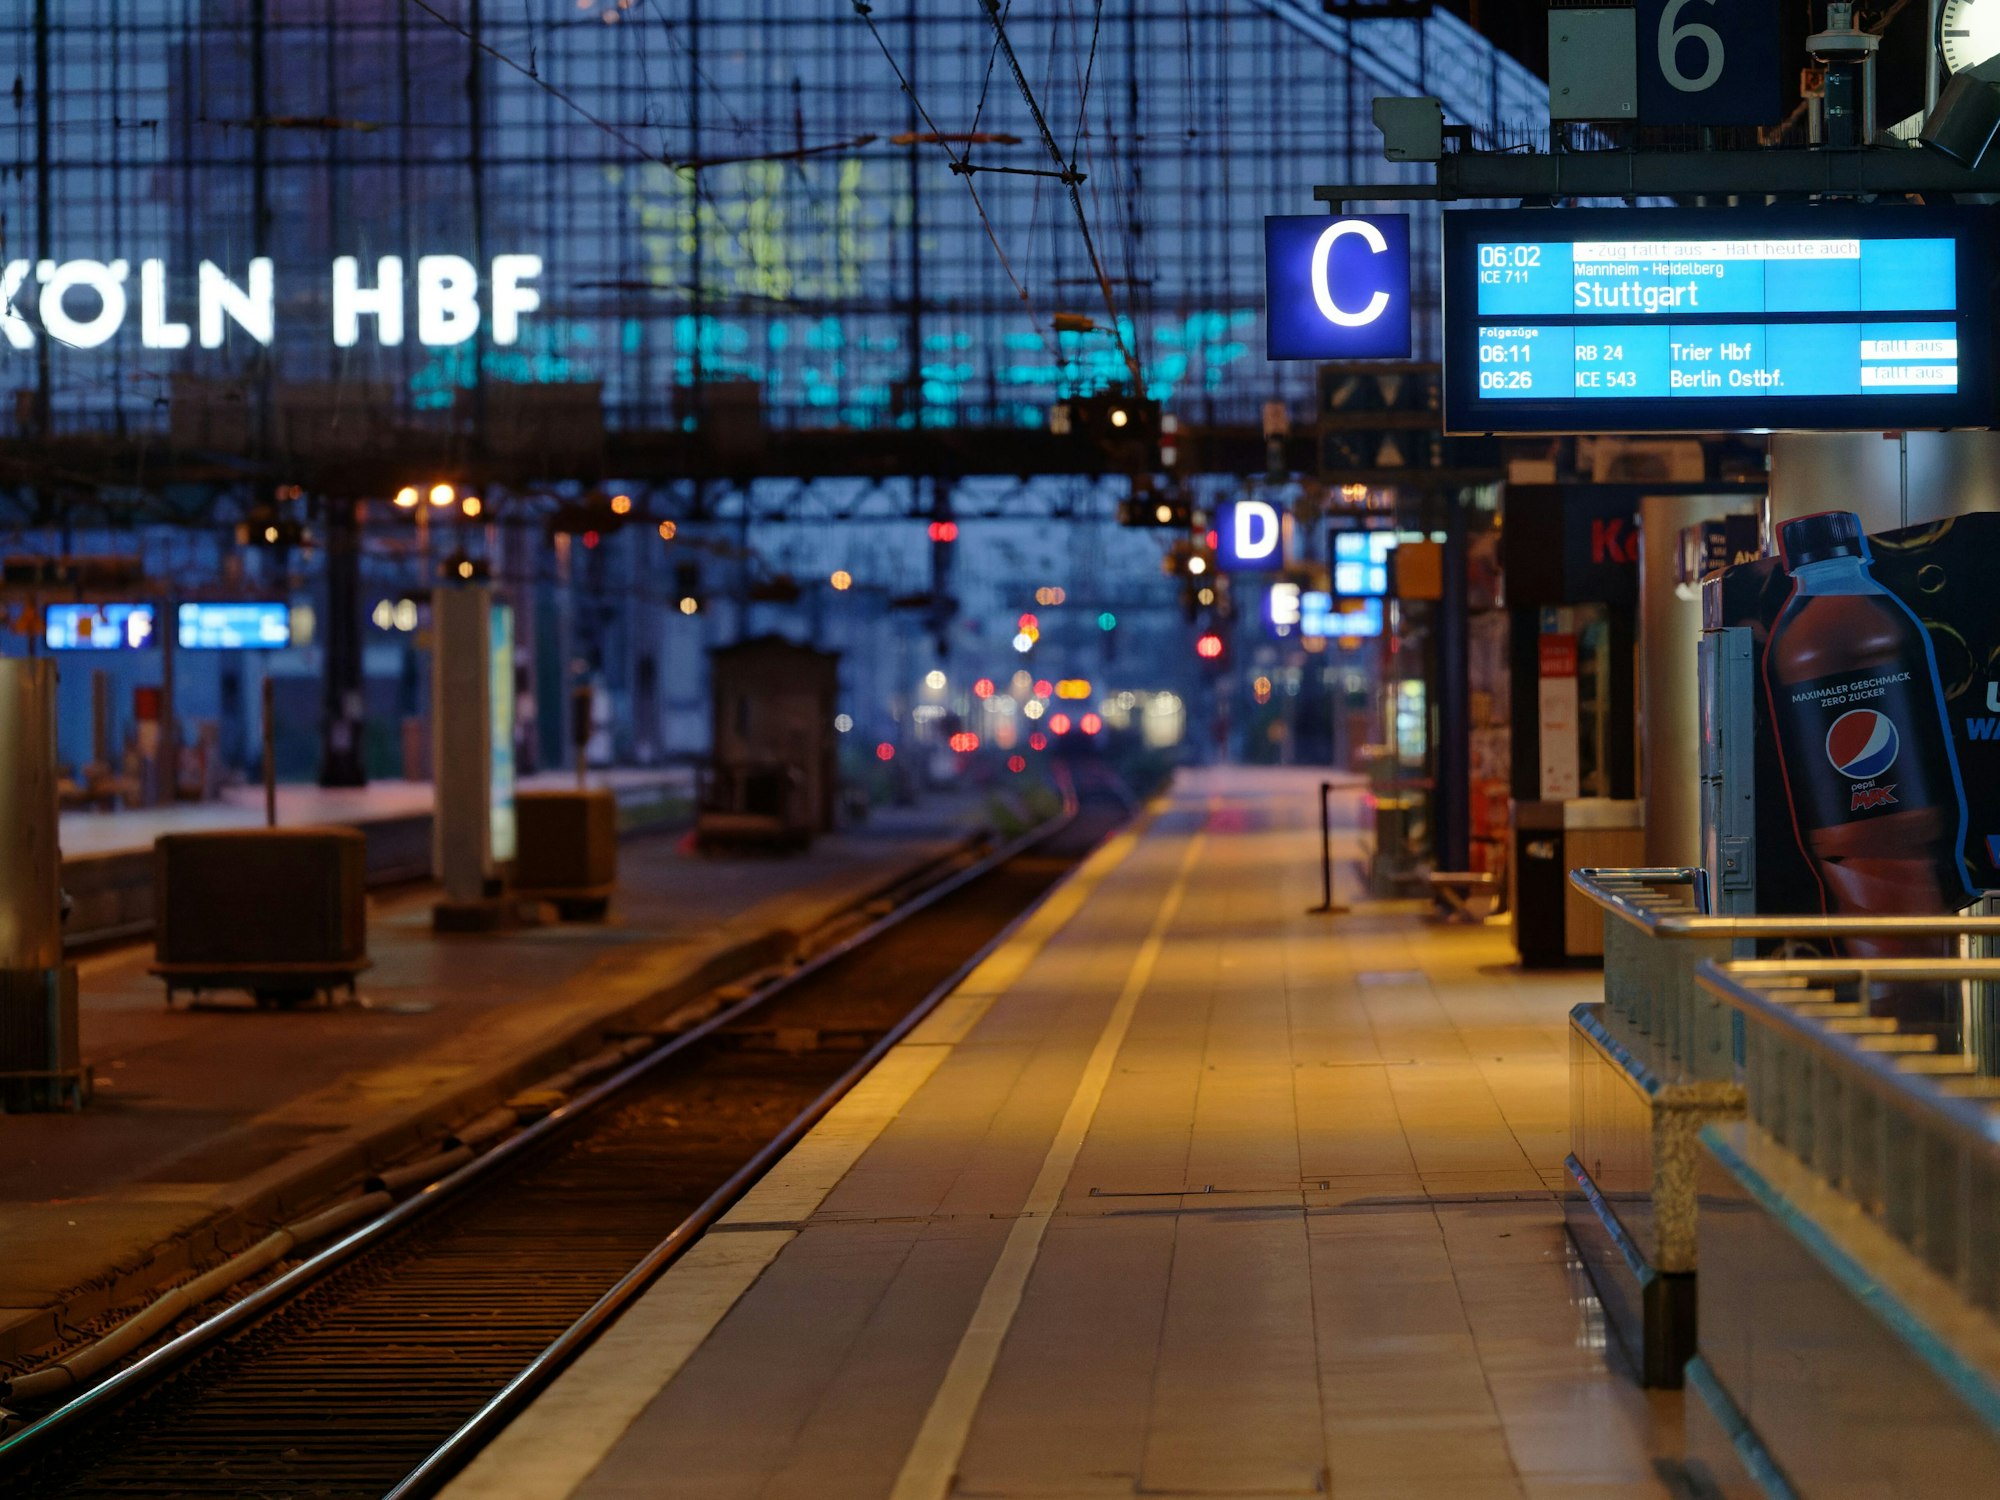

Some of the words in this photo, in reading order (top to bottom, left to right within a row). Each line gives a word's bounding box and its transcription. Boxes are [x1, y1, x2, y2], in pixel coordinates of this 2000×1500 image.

[1657, 0, 1725, 92] 6
[1480, 246, 1541, 267] 06:02
[1598, 245, 1626, 259] Zug
[1674, 245, 1702, 256] aus
[1726, 242, 1758, 256] Halt
[1765, 242, 1814, 255] heute
[1820, 241, 1859, 255] auch
[1311, 219, 1390, 327] C
[1481, 271, 1501, 283] ICE
[1505, 270, 1528, 283] 711
[1574, 263, 1639, 276] Mannheim
[1652, 262, 1724, 277] Heidelberg
[332, 255, 543, 347] HBF
[1574, 281, 1698, 313] Stuttgart
[1480, 327, 1539, 339] Folgezüge
[1480, 344, 1531, 363] 06:11
[1575, 345, 1598, 361] RB
[1603, 344, 1623, 360] 24
[1670, 343, 1712, 361] Trier
[1720, 343, 1752, 361] Hbf
[1915, 341, 1943, 352] aus
[1480, 371, 1533, 389] 06:26
[1576, 371, 1601, 387] ICE
[1606, 371, 1637, 387] 543
[1670, 369, 1721, 388] Berlin
[1728, 368, 1785, 387] Ostbf.
[1915, 368, 1944, 379] aus
[1235, 501, 1279, 559] D
[1271, 582, 1300, 624] E
[1792, 684, 1849, 703] MAXIMALER
[1849, 671, 1911, 691] GESCHMACK
[1820, 694, 1847, 707] ZERO
[1848, 687, 1886, 702] ZUCKER
[1851, 779, 1876, 793] pepsi
[1850, 783, 1899, 811] MAX
